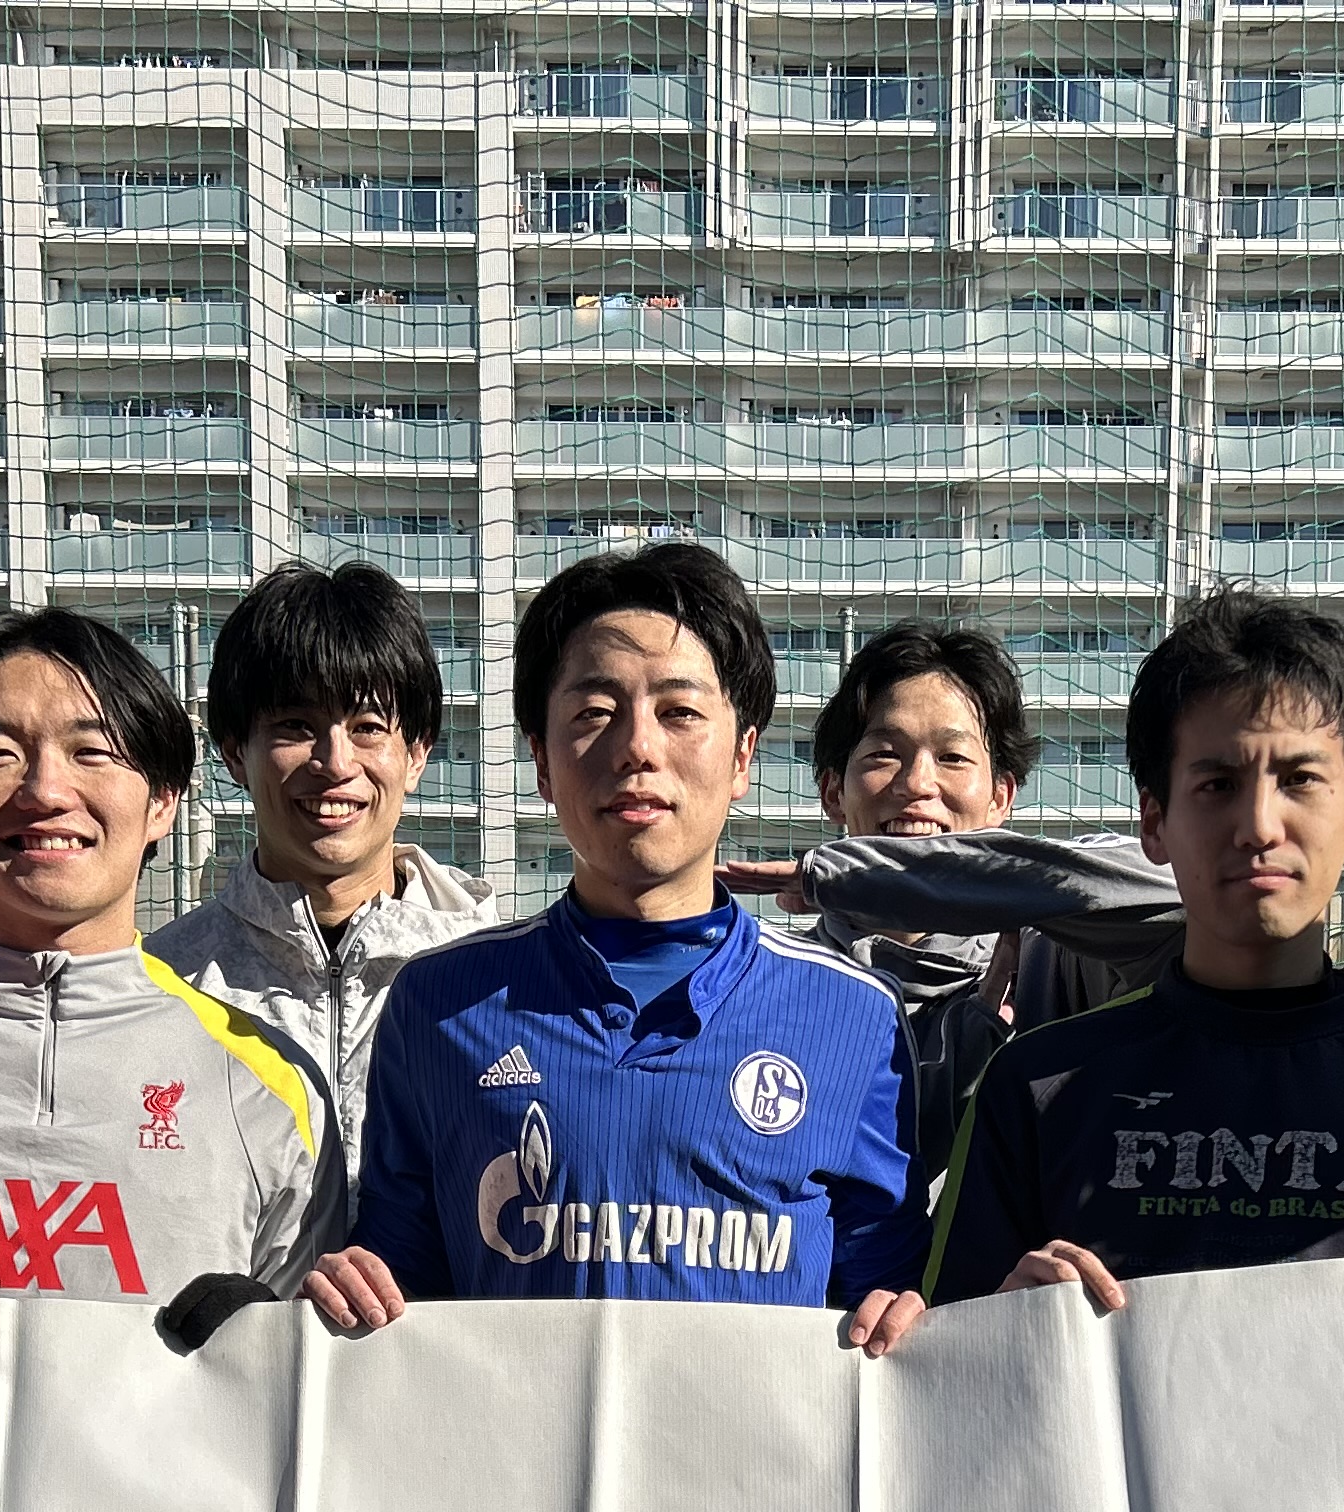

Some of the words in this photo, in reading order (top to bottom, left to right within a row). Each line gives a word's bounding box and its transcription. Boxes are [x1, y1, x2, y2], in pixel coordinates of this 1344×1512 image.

[478, 1071, 542, 1087] adidas
[1137, 1195, 1221, 1217] FINTA
[1230, 1197, 1261, 1219] do
[563, 1202, 792, 1273] GAZPROM
